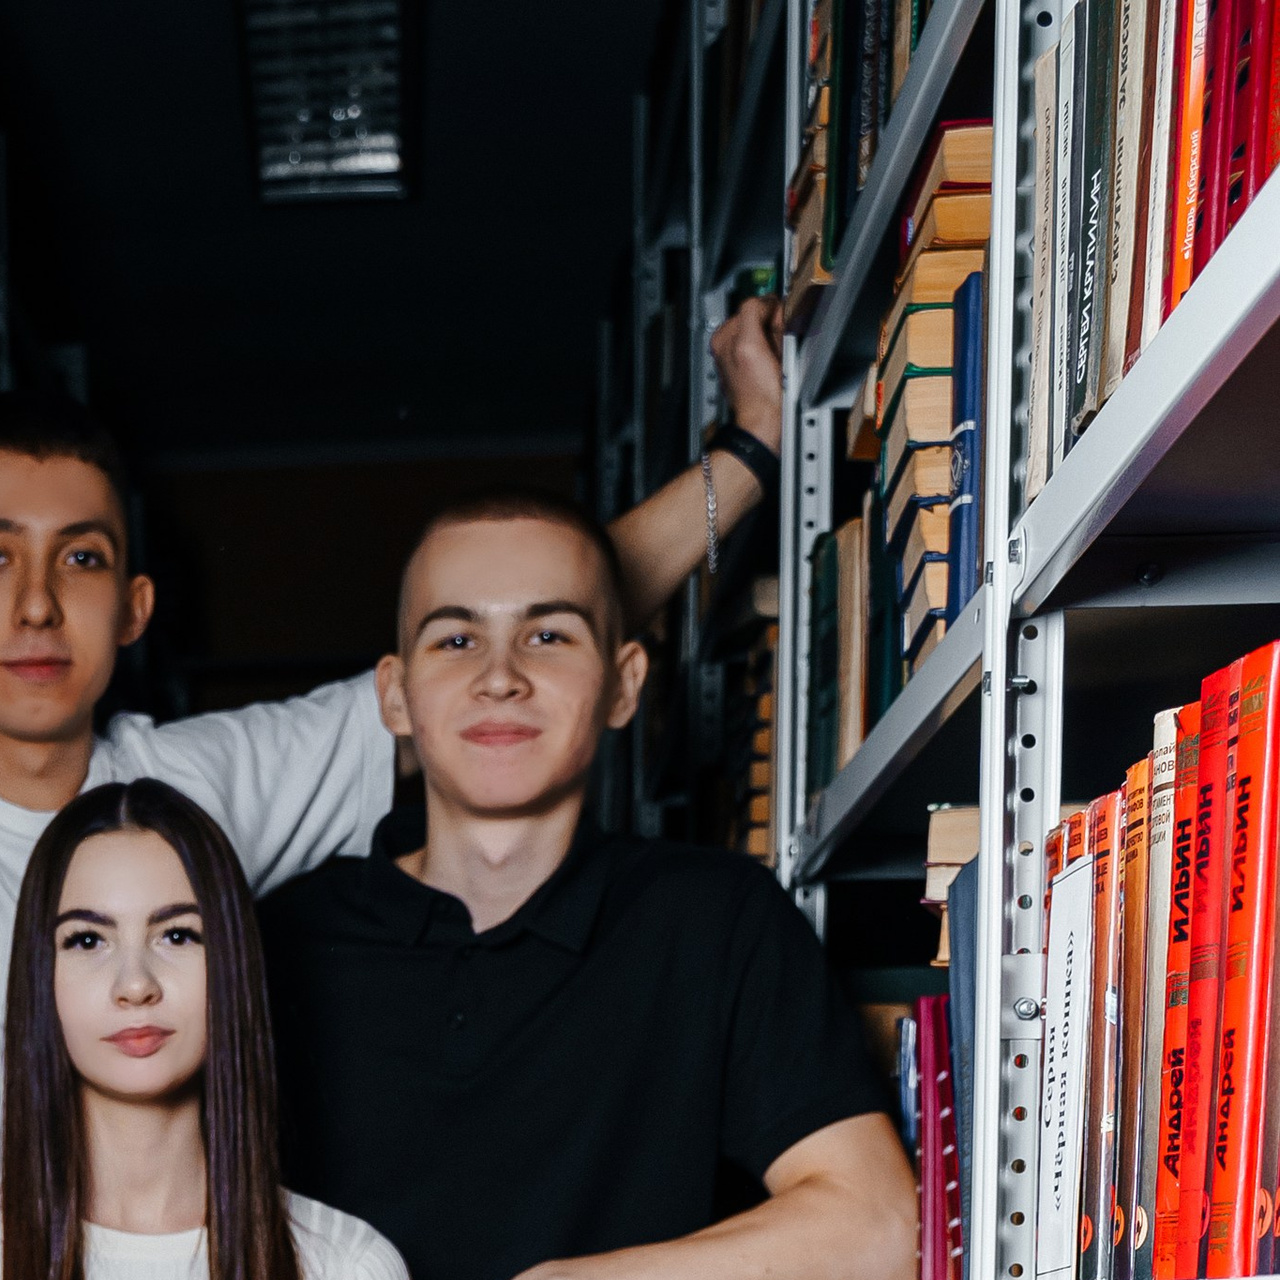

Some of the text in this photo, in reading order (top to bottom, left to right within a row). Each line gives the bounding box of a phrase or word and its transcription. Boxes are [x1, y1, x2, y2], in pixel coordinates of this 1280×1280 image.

[1076, 168, 1103, 385] СЕРГЕЙ КРУТИЛИН
[1183, 129, 1201, 249] Игорь Куберский
[1061, 930, 1076, 1060] кошка»
[1163, 818, 1194, 1179] Андрей ИЛЬИН
[1214, 775, 1253, 1172] Андрей ИЛЬИН
